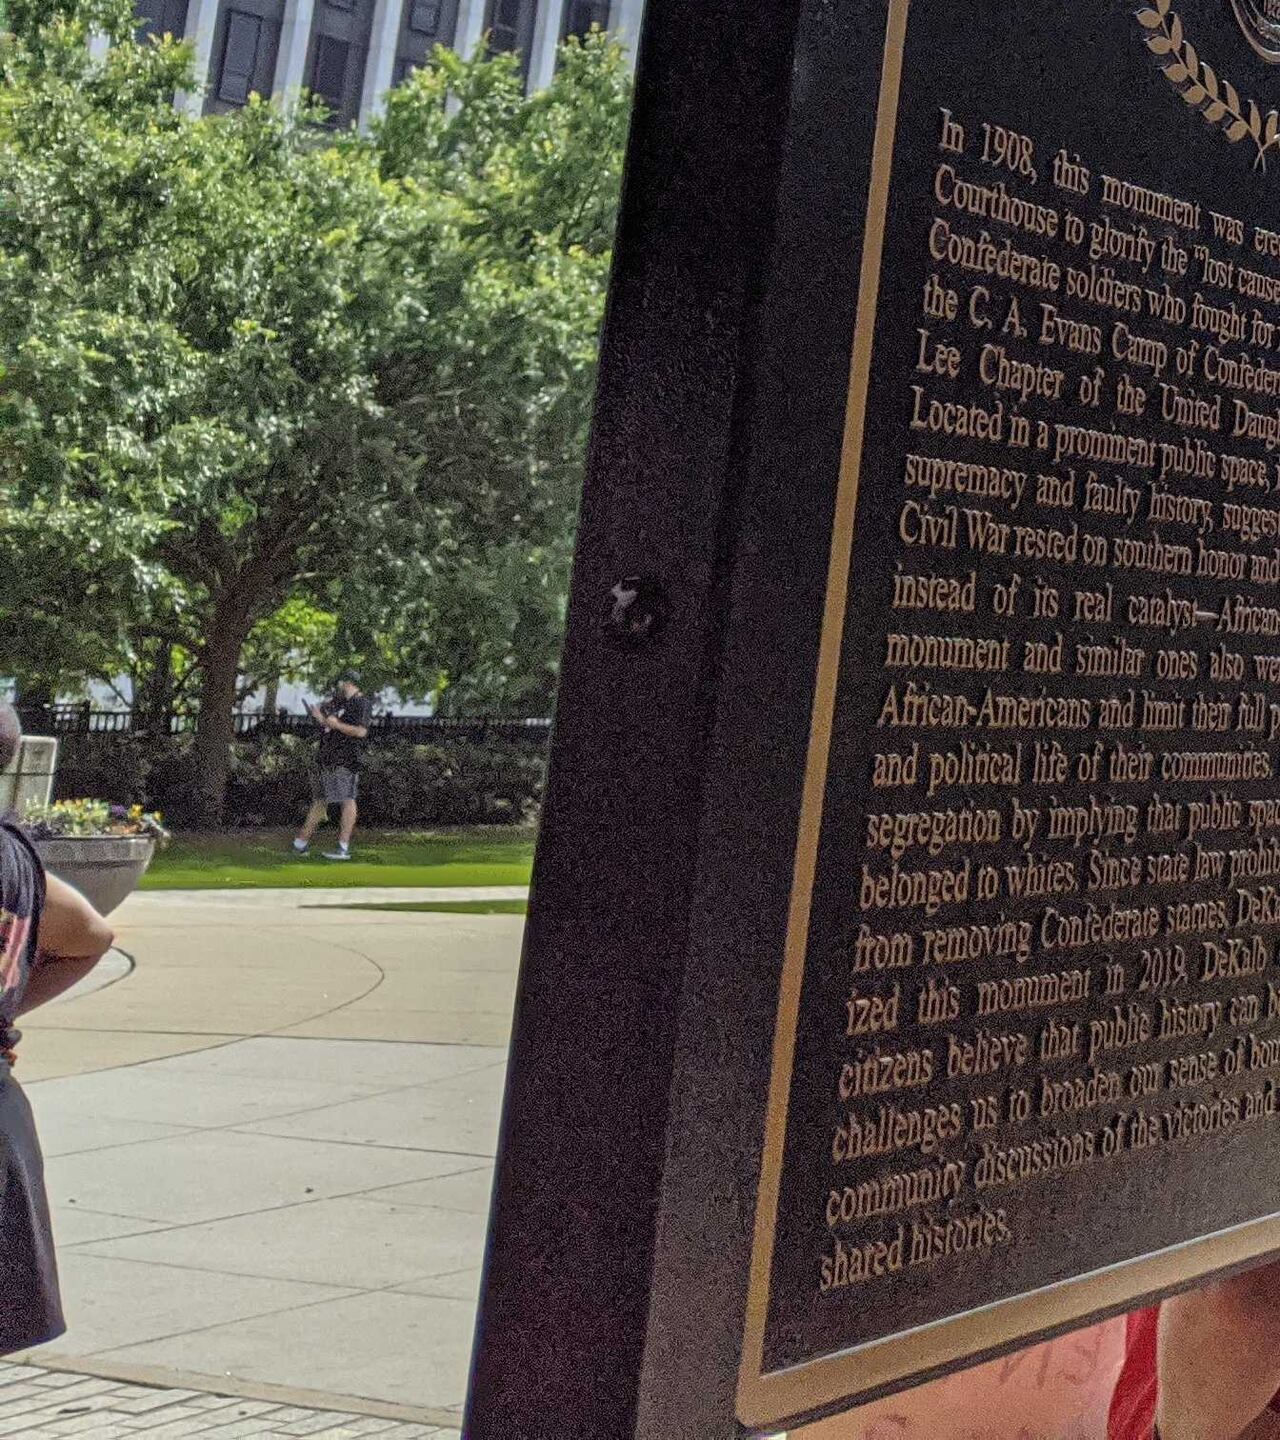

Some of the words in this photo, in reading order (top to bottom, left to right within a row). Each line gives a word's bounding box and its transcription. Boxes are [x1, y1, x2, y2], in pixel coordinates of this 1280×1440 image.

[938, 110, 965, 156] In
[980, 124, 1038, 186] 1908,
[1051, 148, 1091, 196] this
[1100, 175, 1202, 232] monument
[1210, 212, 1245, 246] was
[932, 165, 1059, 240] Courthouse
[1063, 206, 1086, 247] to
[1088, 217, 1155, 278] glorify
[1159, 235, 1189, 277] the
[926, 219, 1061, 292] Confederate
[1065, 264, 1143, 314] soldiers
[1145, 285, 1187, 325] who
[1190, 293, 1248, 346] fought
[1249, 309, 1275, 348] for
[921, 274, 959, 322] the
[966, 286, 993, 330] C.
[1001, 294, 1028, 338] A.
[1039, 304, 1103, 355] Evans
[1109, 321, 1168, 380] Camp
[1174, 340, 1197, 376] of
[915, 331, 962, 379] Lee
[977, 344, 1065, 405] Chapter
[1078, 369, 1103, 407] of
[1115, 375, 1147, 416] the
[1160, 384, 1222, 431] United
[909, 388, 1004, 443] Located
[1007, 406, 1031, 448] in
[1035, 422, 1050, 451] a
[1053, 425, 1158, 469] prominent
[1159, 439, 1216, 482] public
[903, 455, 1027, 511] supremacy
[1035, 468, 1076, 507] and
[1082, 472, 1141, 526] faulty
[1149, 482, 1213, 536] history,
[896, 502, 959, 549] Civil
[965, 511, 1011, 555] War
[1013, 521, 1079, 562] rested
[1081, 536, 1109, 565] on
[1112, 534, 1193, 574] southern
[891, 565, 978, 612] instead
[991, 576, 1018, 615] of
[1031, 579, 1060, 619] its
[1072, 585, 1114, 623] real
[884, 630, 1011, 670] monument
[1022, 633, 1064, 672] and
[1075, 636, 1145, 676] similar
[876, 683, 1092, 727] African-Americans
[1097, 691, 1136, 728] and
[1141, 692, 1187, 728] limit
[871, 744, 919, 786] and
[927, 744, 1022, 796] political
[1032, 744, 1069, 782] life
[1076, 744, 1101, 782] of
[1108, 744, 1154, 781] their
[866, 799, 1002, 855] segregation
[1011, 798, 1040, 848] by
[1047, 795, 1139, 845] implying
[859, 858, 971, 913] belonged
[975, 857, 1000, 897] to
[1003, 853, 1079, 895] whites.
[1087, 850, 1142, 888] Since
[852, 927, 915, 971] from
[921, 914, 1033, 963] removing
[1039, 901, 1160, 949] Confederate
[844, 983, 900, 1033] ized
[915, 977, 961, 1023] this
[975, 960, 1092, 1014] monument
[1103, 957, 1126, 996] in
[837, 1046, 935, 1096] citizens
[946, 1029, 1029, 1077] believe
[1038, 1015, 1081, 1061] that
[1088, 1006, 1151, 1063] public
[830, 1103, 964, 1159] challenges
[969, 1096, 1000, 1131] us
[1007, 1081, 1032, 1123] to
[1040, 1066, 1122, 1116] broaden
[824, 1152, 966, 1223] community
[972, 1128, 1099, 1188] discussions
[1101, 1115, 1123, 1157] of
[819, 1225, 906, 1290] shared
[910, 1205, 1012, 1265] histories.
